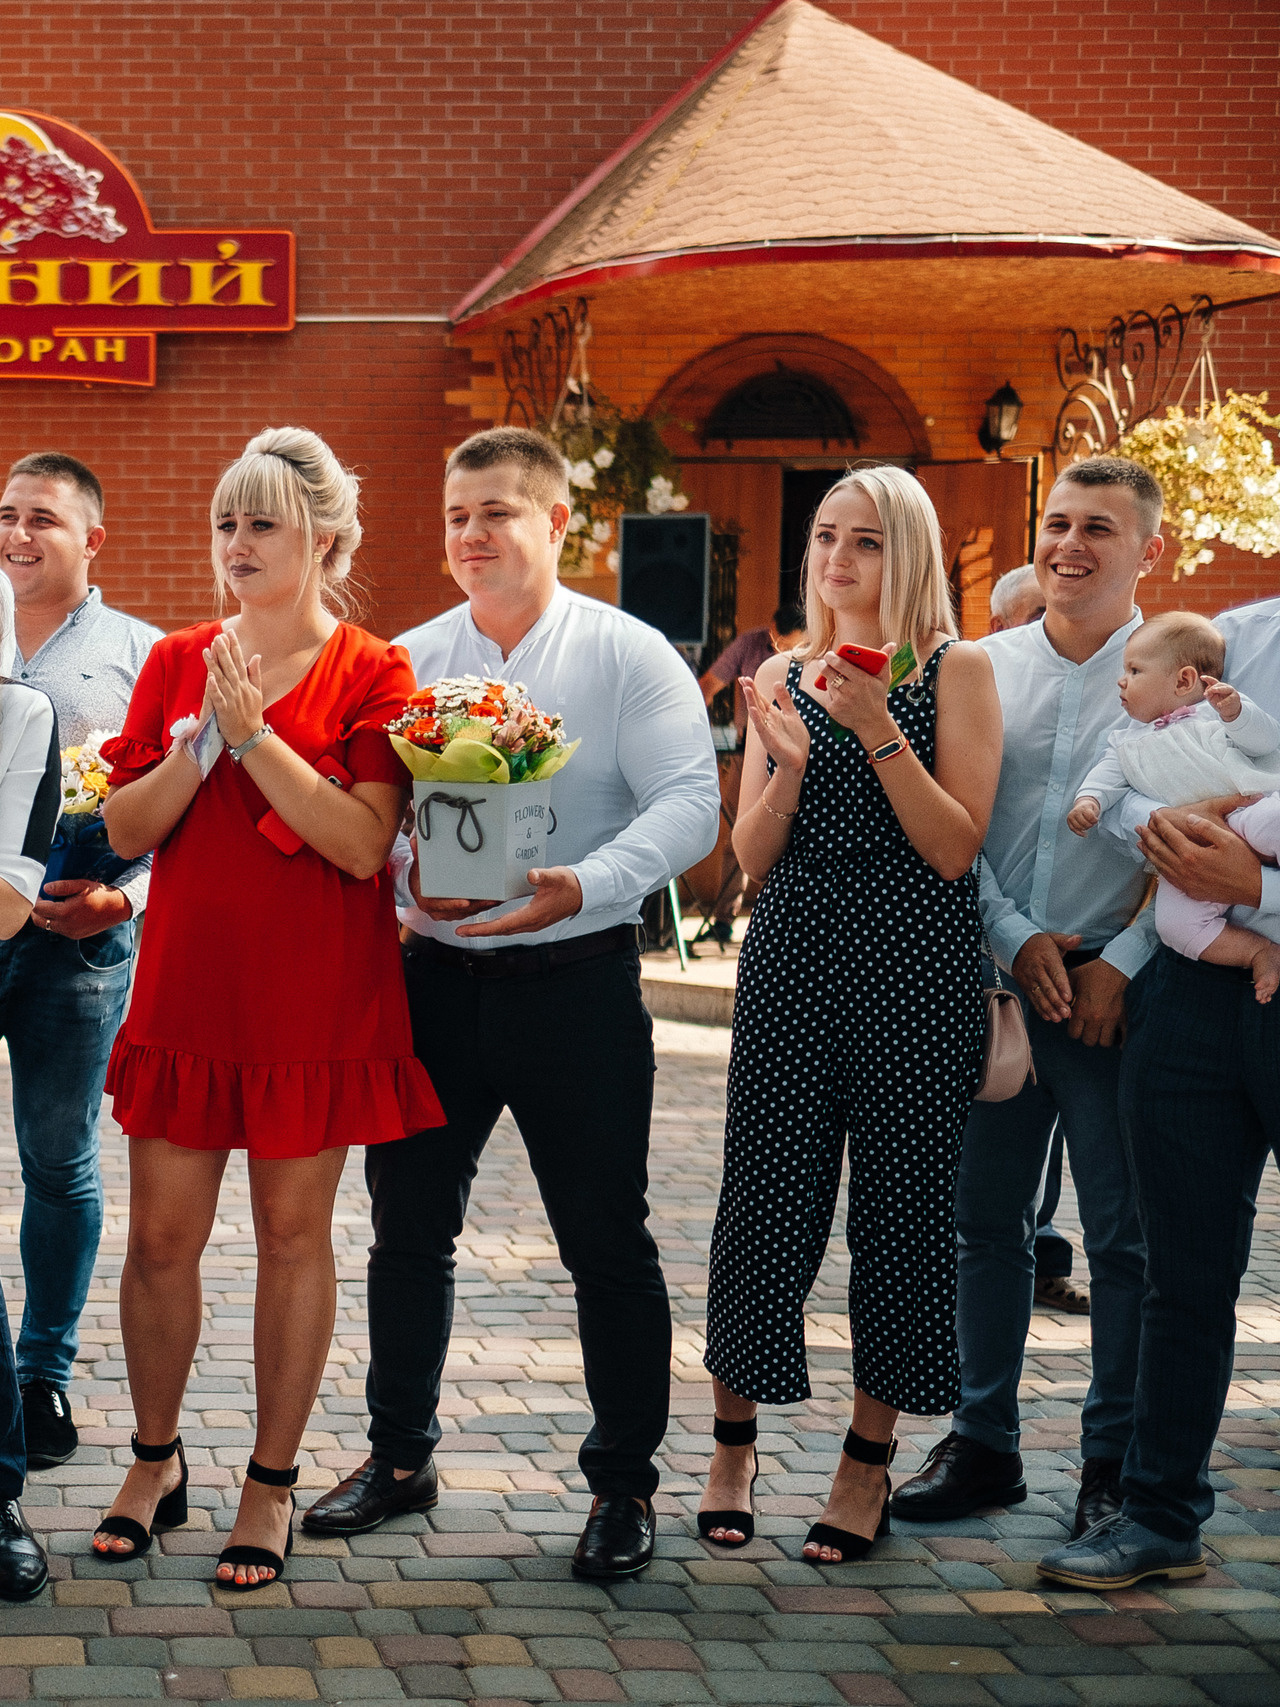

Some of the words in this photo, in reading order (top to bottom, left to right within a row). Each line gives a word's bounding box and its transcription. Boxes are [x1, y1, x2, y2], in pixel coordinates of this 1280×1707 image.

[514, 804, 545, 823] FLOWERS
[526, 827, 532, 839] &
[515, 845, 539, 860] GARDEN
